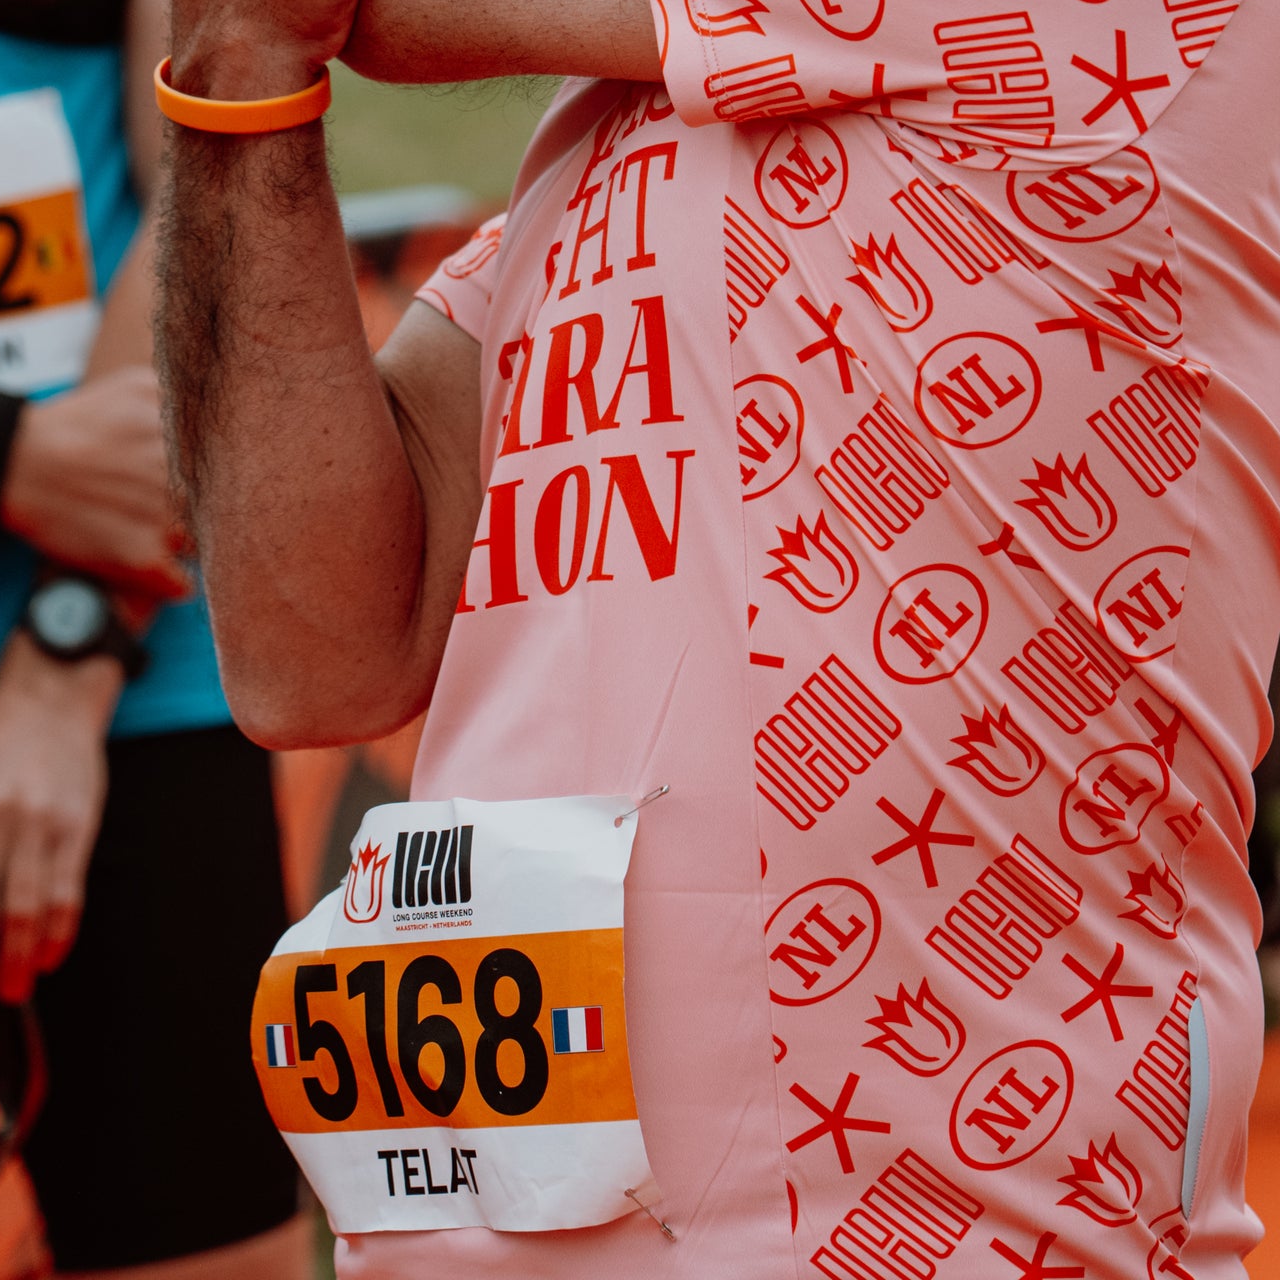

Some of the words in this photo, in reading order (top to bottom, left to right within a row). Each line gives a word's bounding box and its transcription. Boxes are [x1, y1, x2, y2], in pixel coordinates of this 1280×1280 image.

[769, 134, 838, 215] NL
[1023, 163, 1146, 231] NL
[927, 352, 1027, 436] NL
[453, 449, 696, 615] HON
[888, 587, 975, 670] NL
[1072, 763, 1157, 838] NL
[392, 913, 411, 923] LONG
[412, 911, 438, 921] COURSE
[439, 908, 474, 919] WEEKEND
[395, 923, 428, 932] MAASTRICHT
[433, 920, 473, 929] NETHERLANDS
[768, 902, 868, 991] NL
[293, 947, 549, 1123] 5168
[963, 1066, 1061, 1155] NL
[376, 1146, 480, 1197] TELAT
